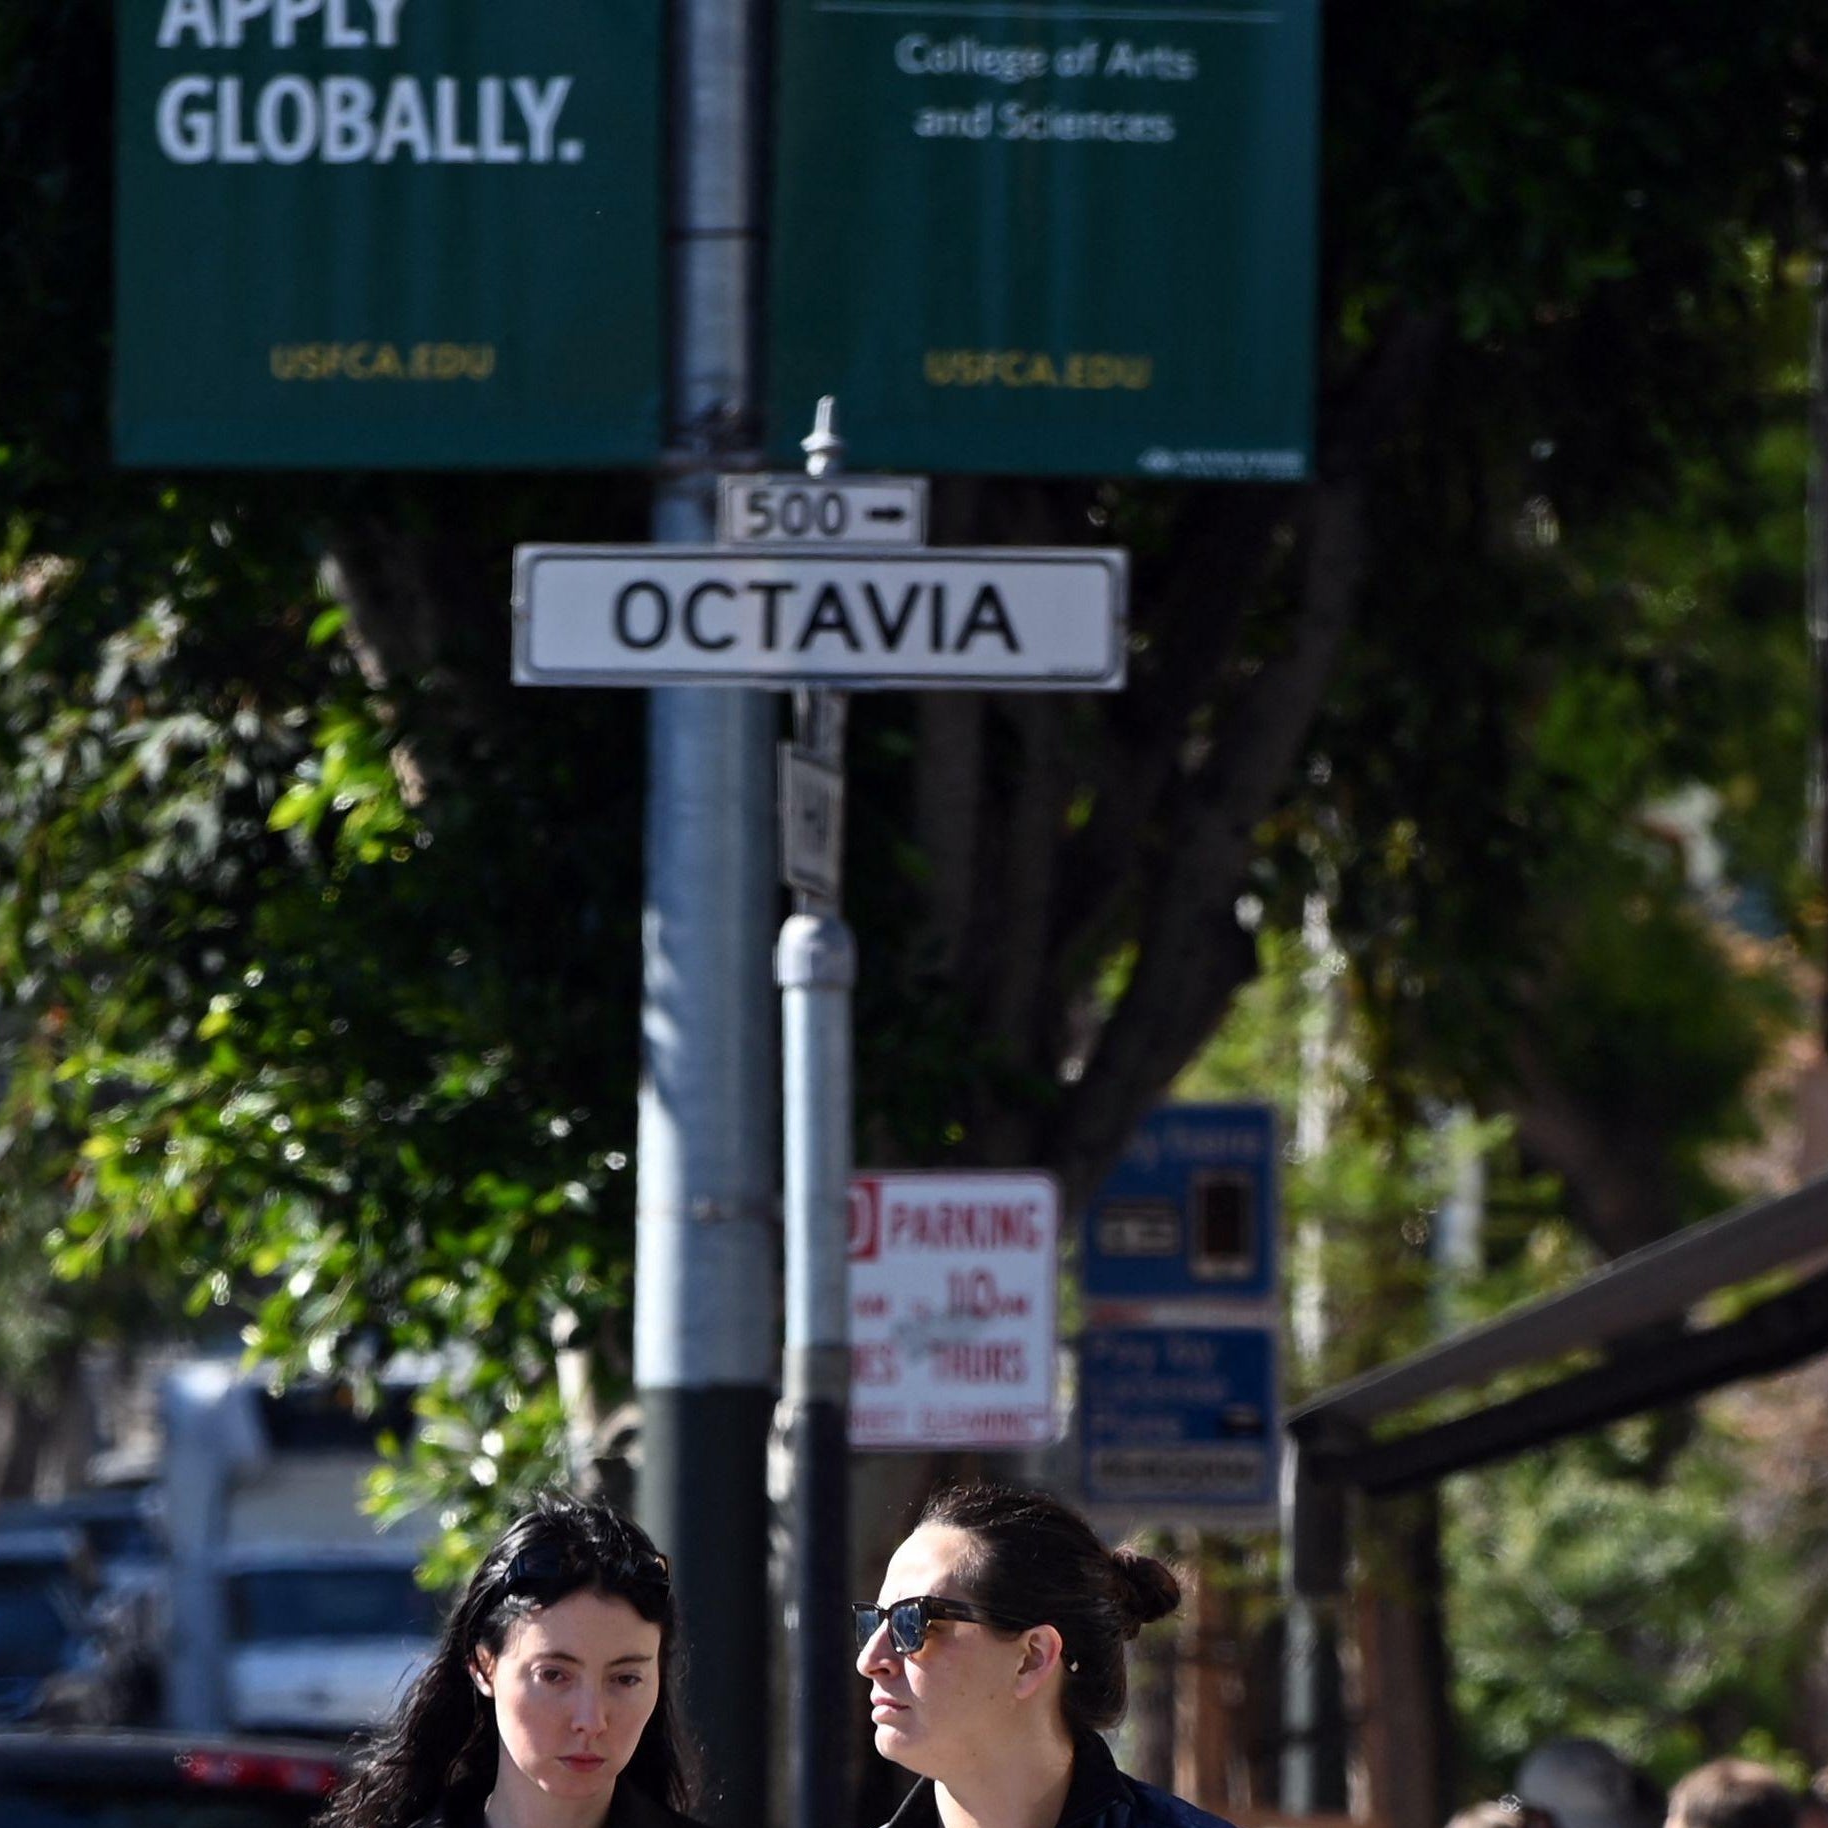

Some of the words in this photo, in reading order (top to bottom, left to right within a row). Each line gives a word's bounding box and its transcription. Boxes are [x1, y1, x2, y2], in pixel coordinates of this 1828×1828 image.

[156, 0, 407, 49] APPLY
[895, 34, 1048, 84] College
[1055, 41, 1100, 78] of
[1105, 42, 1199, 80] Arts
[155, 73, 585, 164] GLOBALLY.
[913, 101, 993, 138] and
[998, 102, 1176, 142] Sciences
[271, 341, 497, 380] USFCA.EDU
[925, 349, 1153, 390] USFCA.EDU
[745, 490, 849, 537] 500
[613, 581, 1021, 652] OCTAVIA
[890, 1204, 1043, 1250] PARKING
